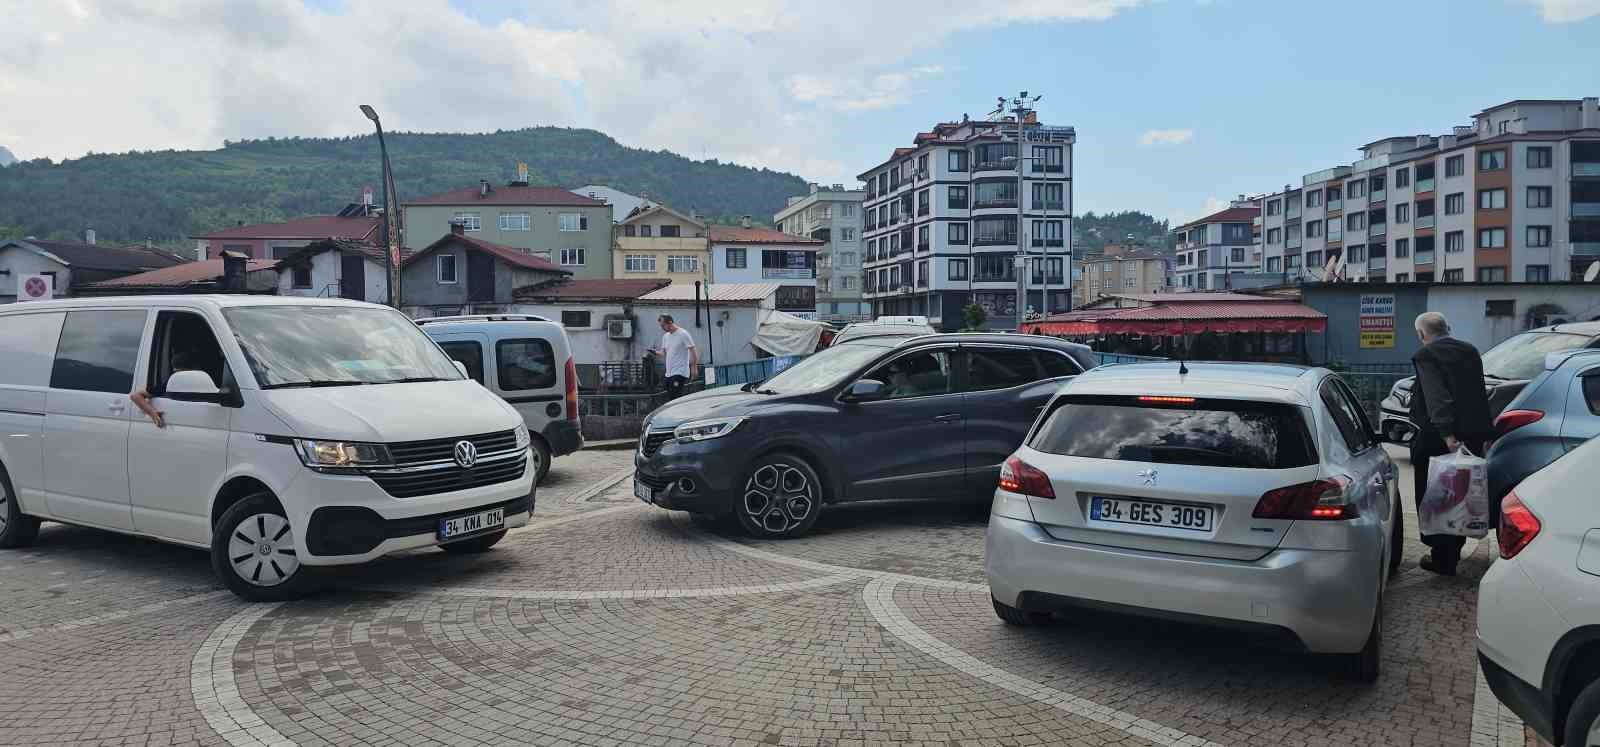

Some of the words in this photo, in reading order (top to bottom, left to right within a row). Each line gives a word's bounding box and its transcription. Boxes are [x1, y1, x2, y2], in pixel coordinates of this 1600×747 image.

[447, 521, 458, 536] 34
[464, 514, 481, 532] KNA
[487, 511, 502, 525] 014
[1101, 500, 1122, 519] 34
[1129, 502, 1164, 523] GES
[1171, 506, 1206, 527] 309
